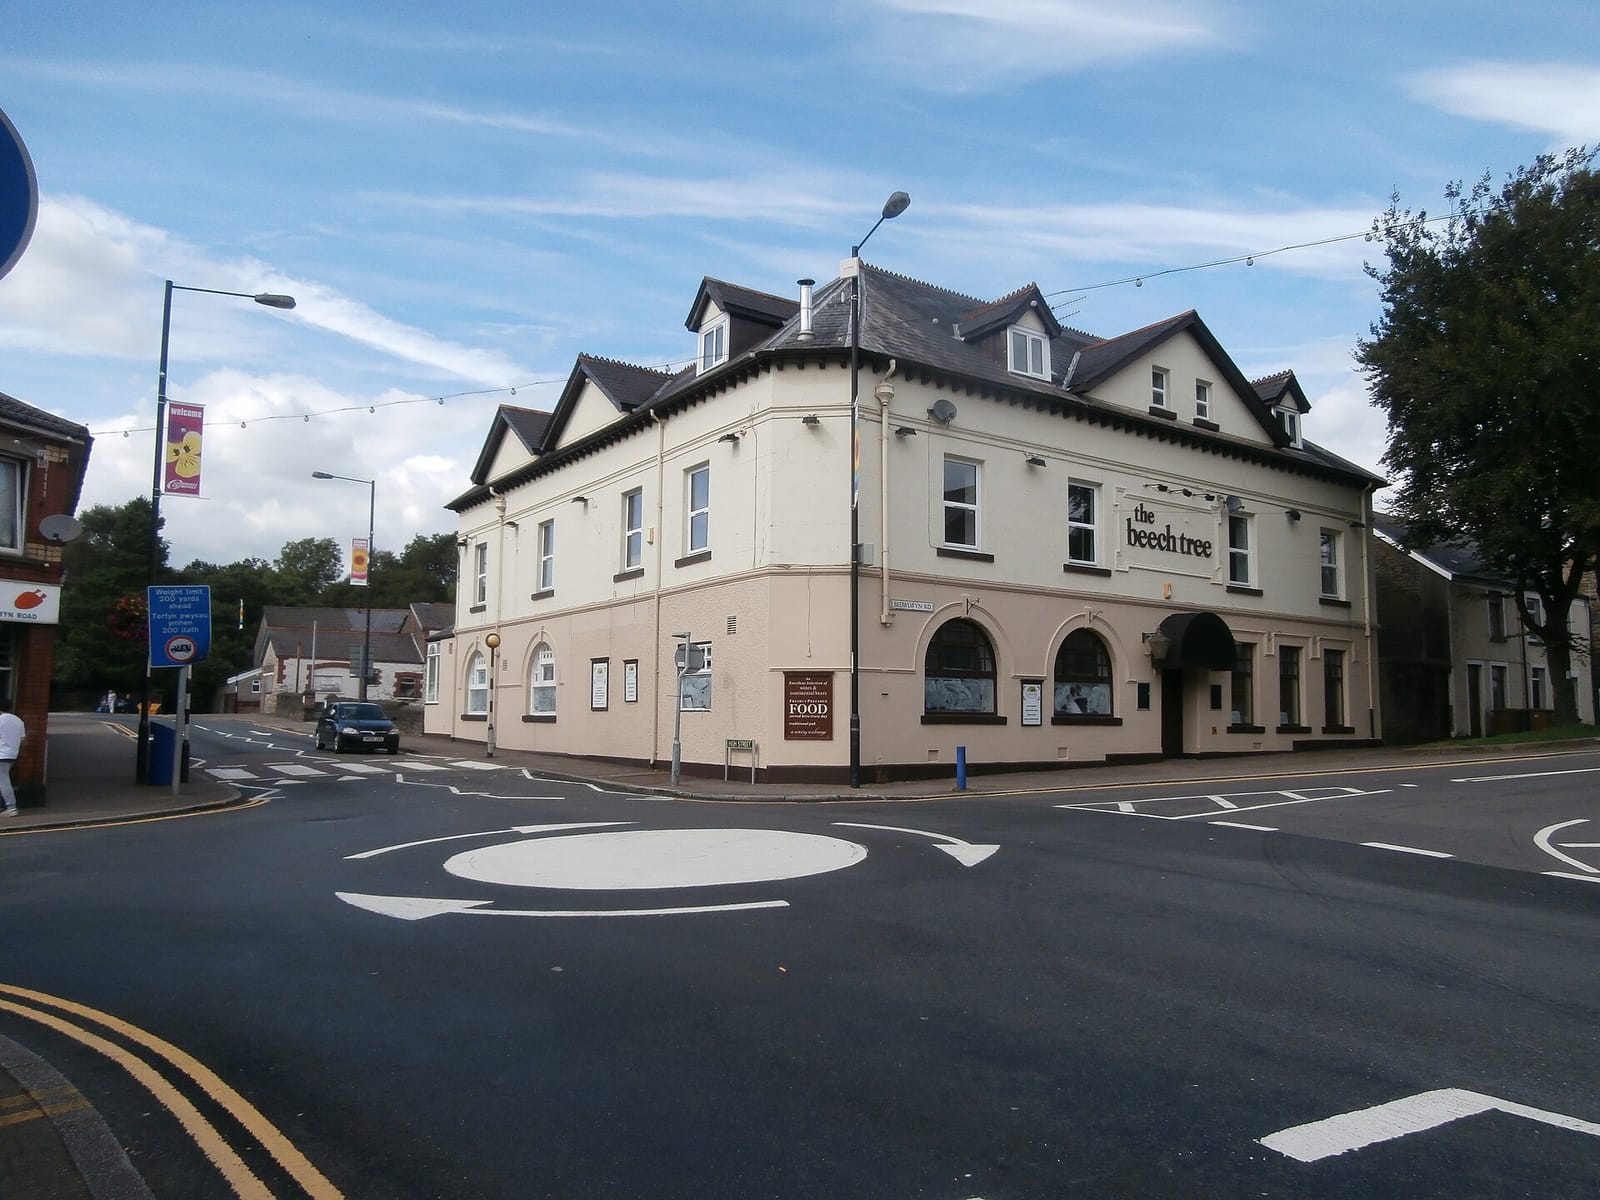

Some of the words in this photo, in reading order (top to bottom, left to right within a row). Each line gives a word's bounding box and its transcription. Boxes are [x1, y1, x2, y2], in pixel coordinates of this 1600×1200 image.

[171, 407, 202, 418] welcome
[1134, 503, 1155, 524] the
[1126, 517, 1177, 552] beech
[1179, 532, 1212, 558] tree
[17, 612, 38, 620] ROAD
[789, 703, 828, 714] FOOD
